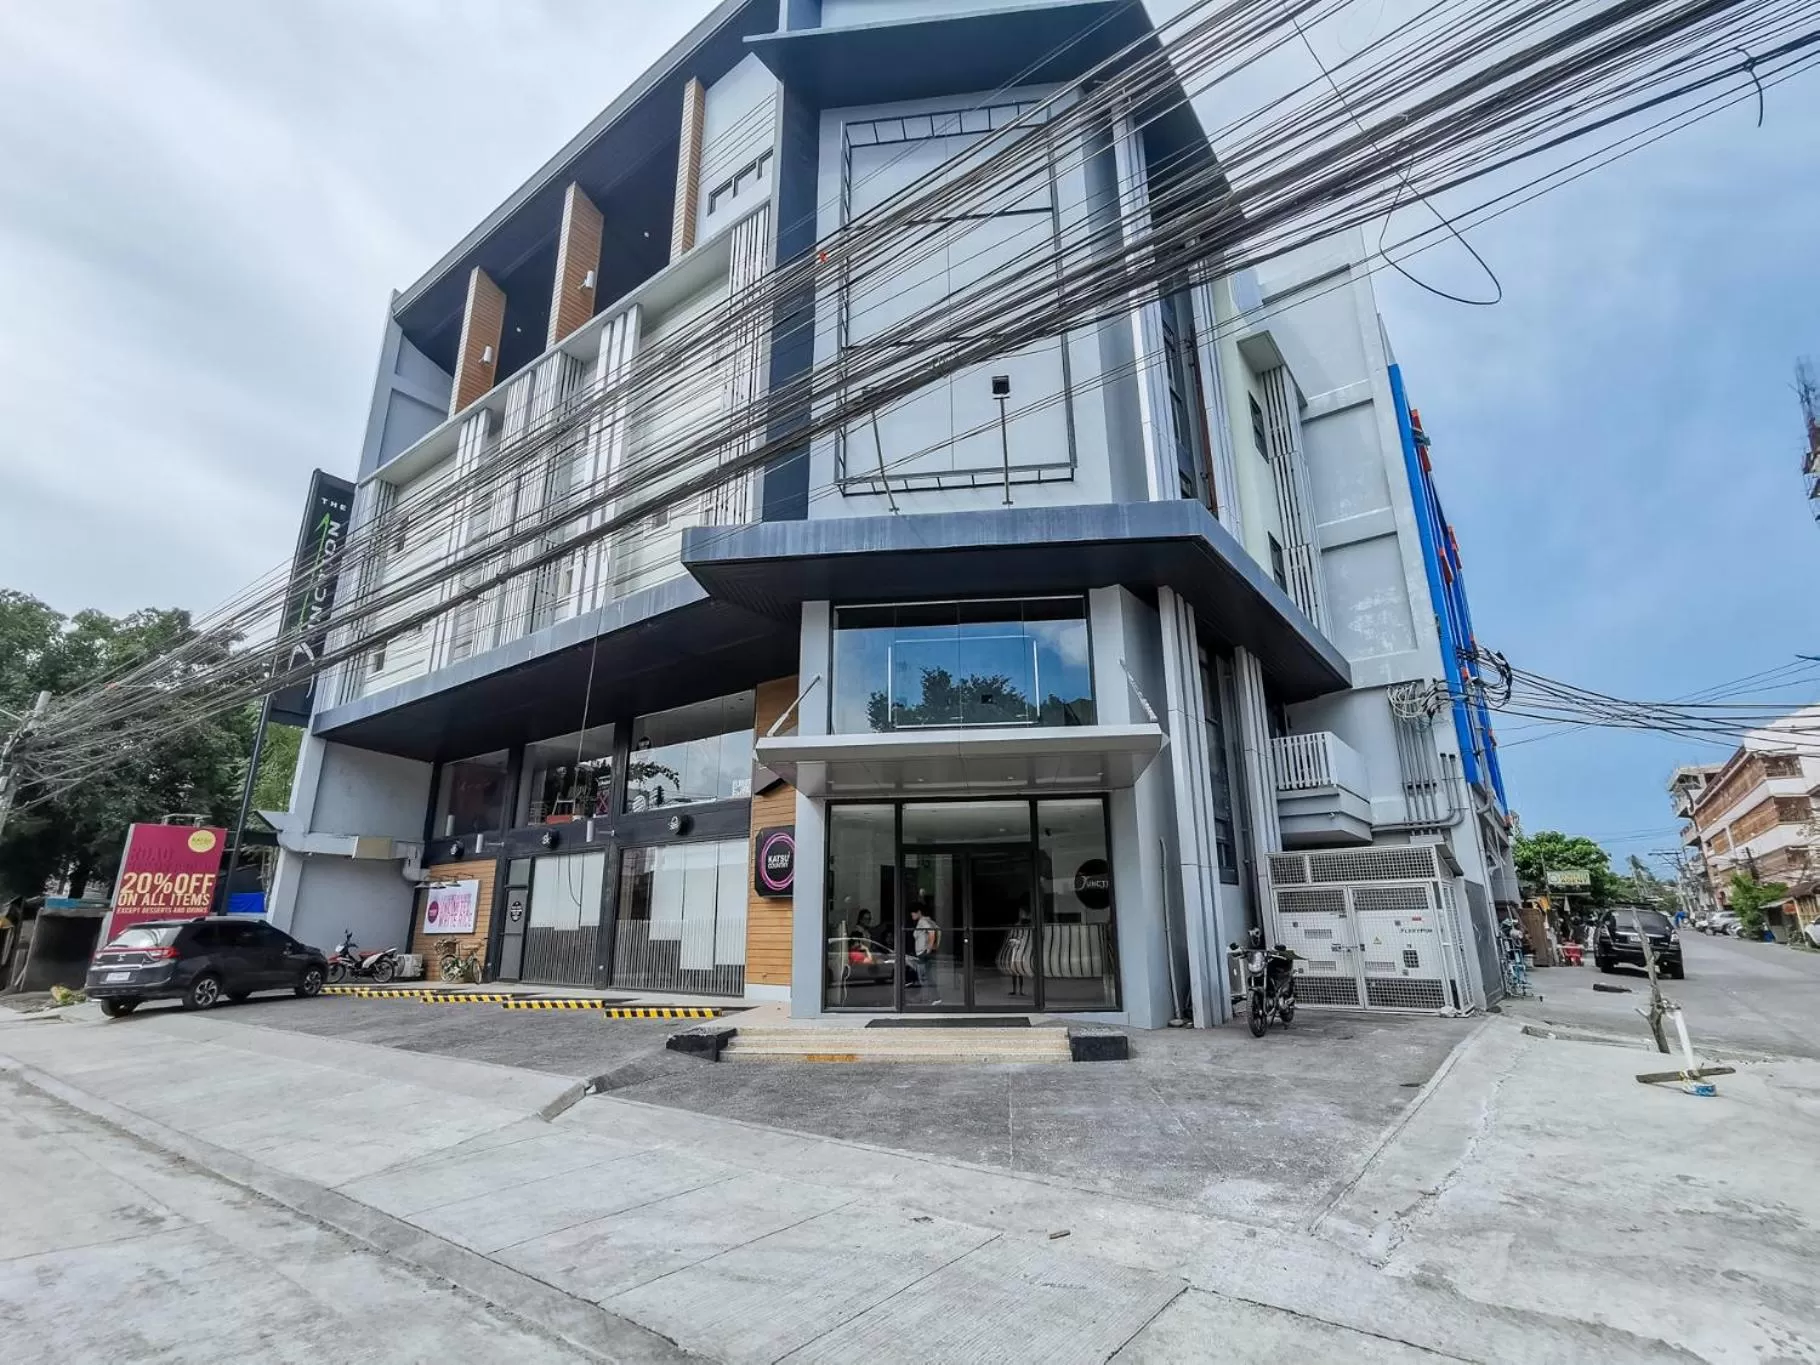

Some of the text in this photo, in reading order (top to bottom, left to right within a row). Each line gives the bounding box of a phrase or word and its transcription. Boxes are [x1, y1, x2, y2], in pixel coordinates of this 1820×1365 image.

[321, 497, 347, 512] THE
[768, 852, 790, 862] KATSU
[117, 893, 211, 906] ON ALL ITEMS
